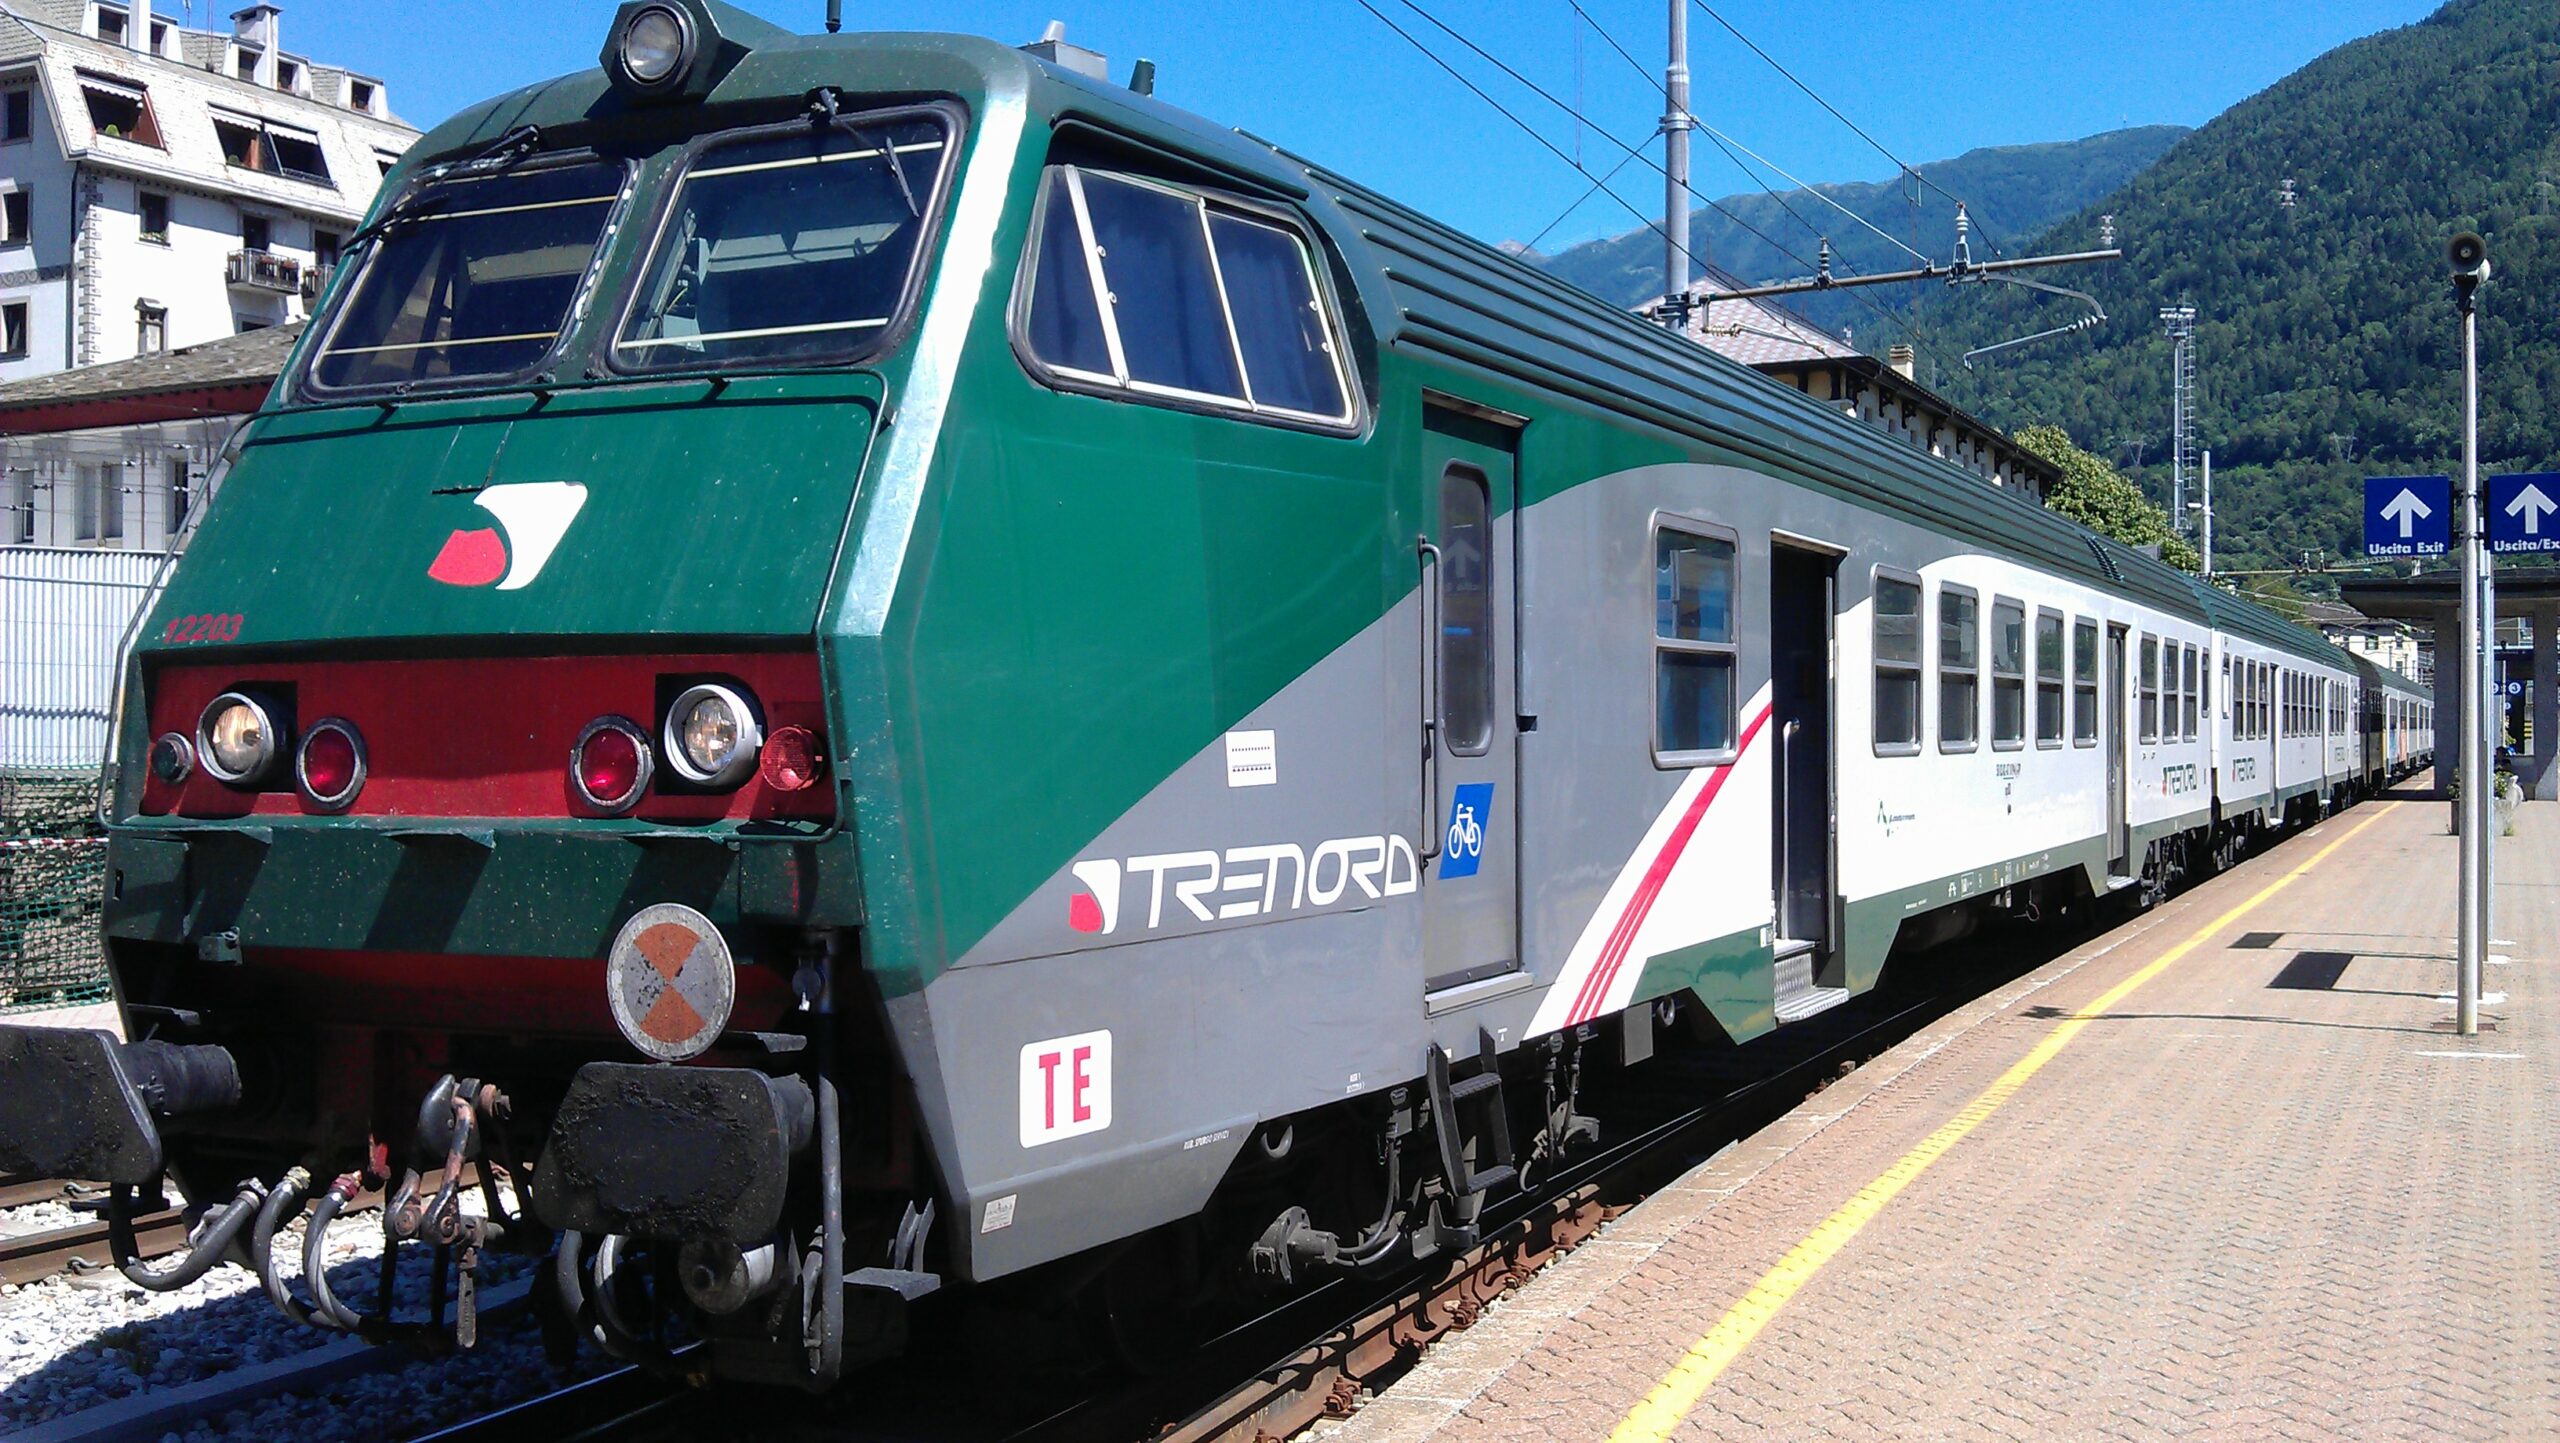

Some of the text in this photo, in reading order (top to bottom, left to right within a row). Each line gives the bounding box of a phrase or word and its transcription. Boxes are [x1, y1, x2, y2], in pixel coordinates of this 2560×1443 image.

[2369, 541, 2445, 555] Uscita Exit
[163, 613, 244, 644] 12203
[1126, 834, 1417, 928] TRENORD
[1038, 1045, 1091, 1129] TE
